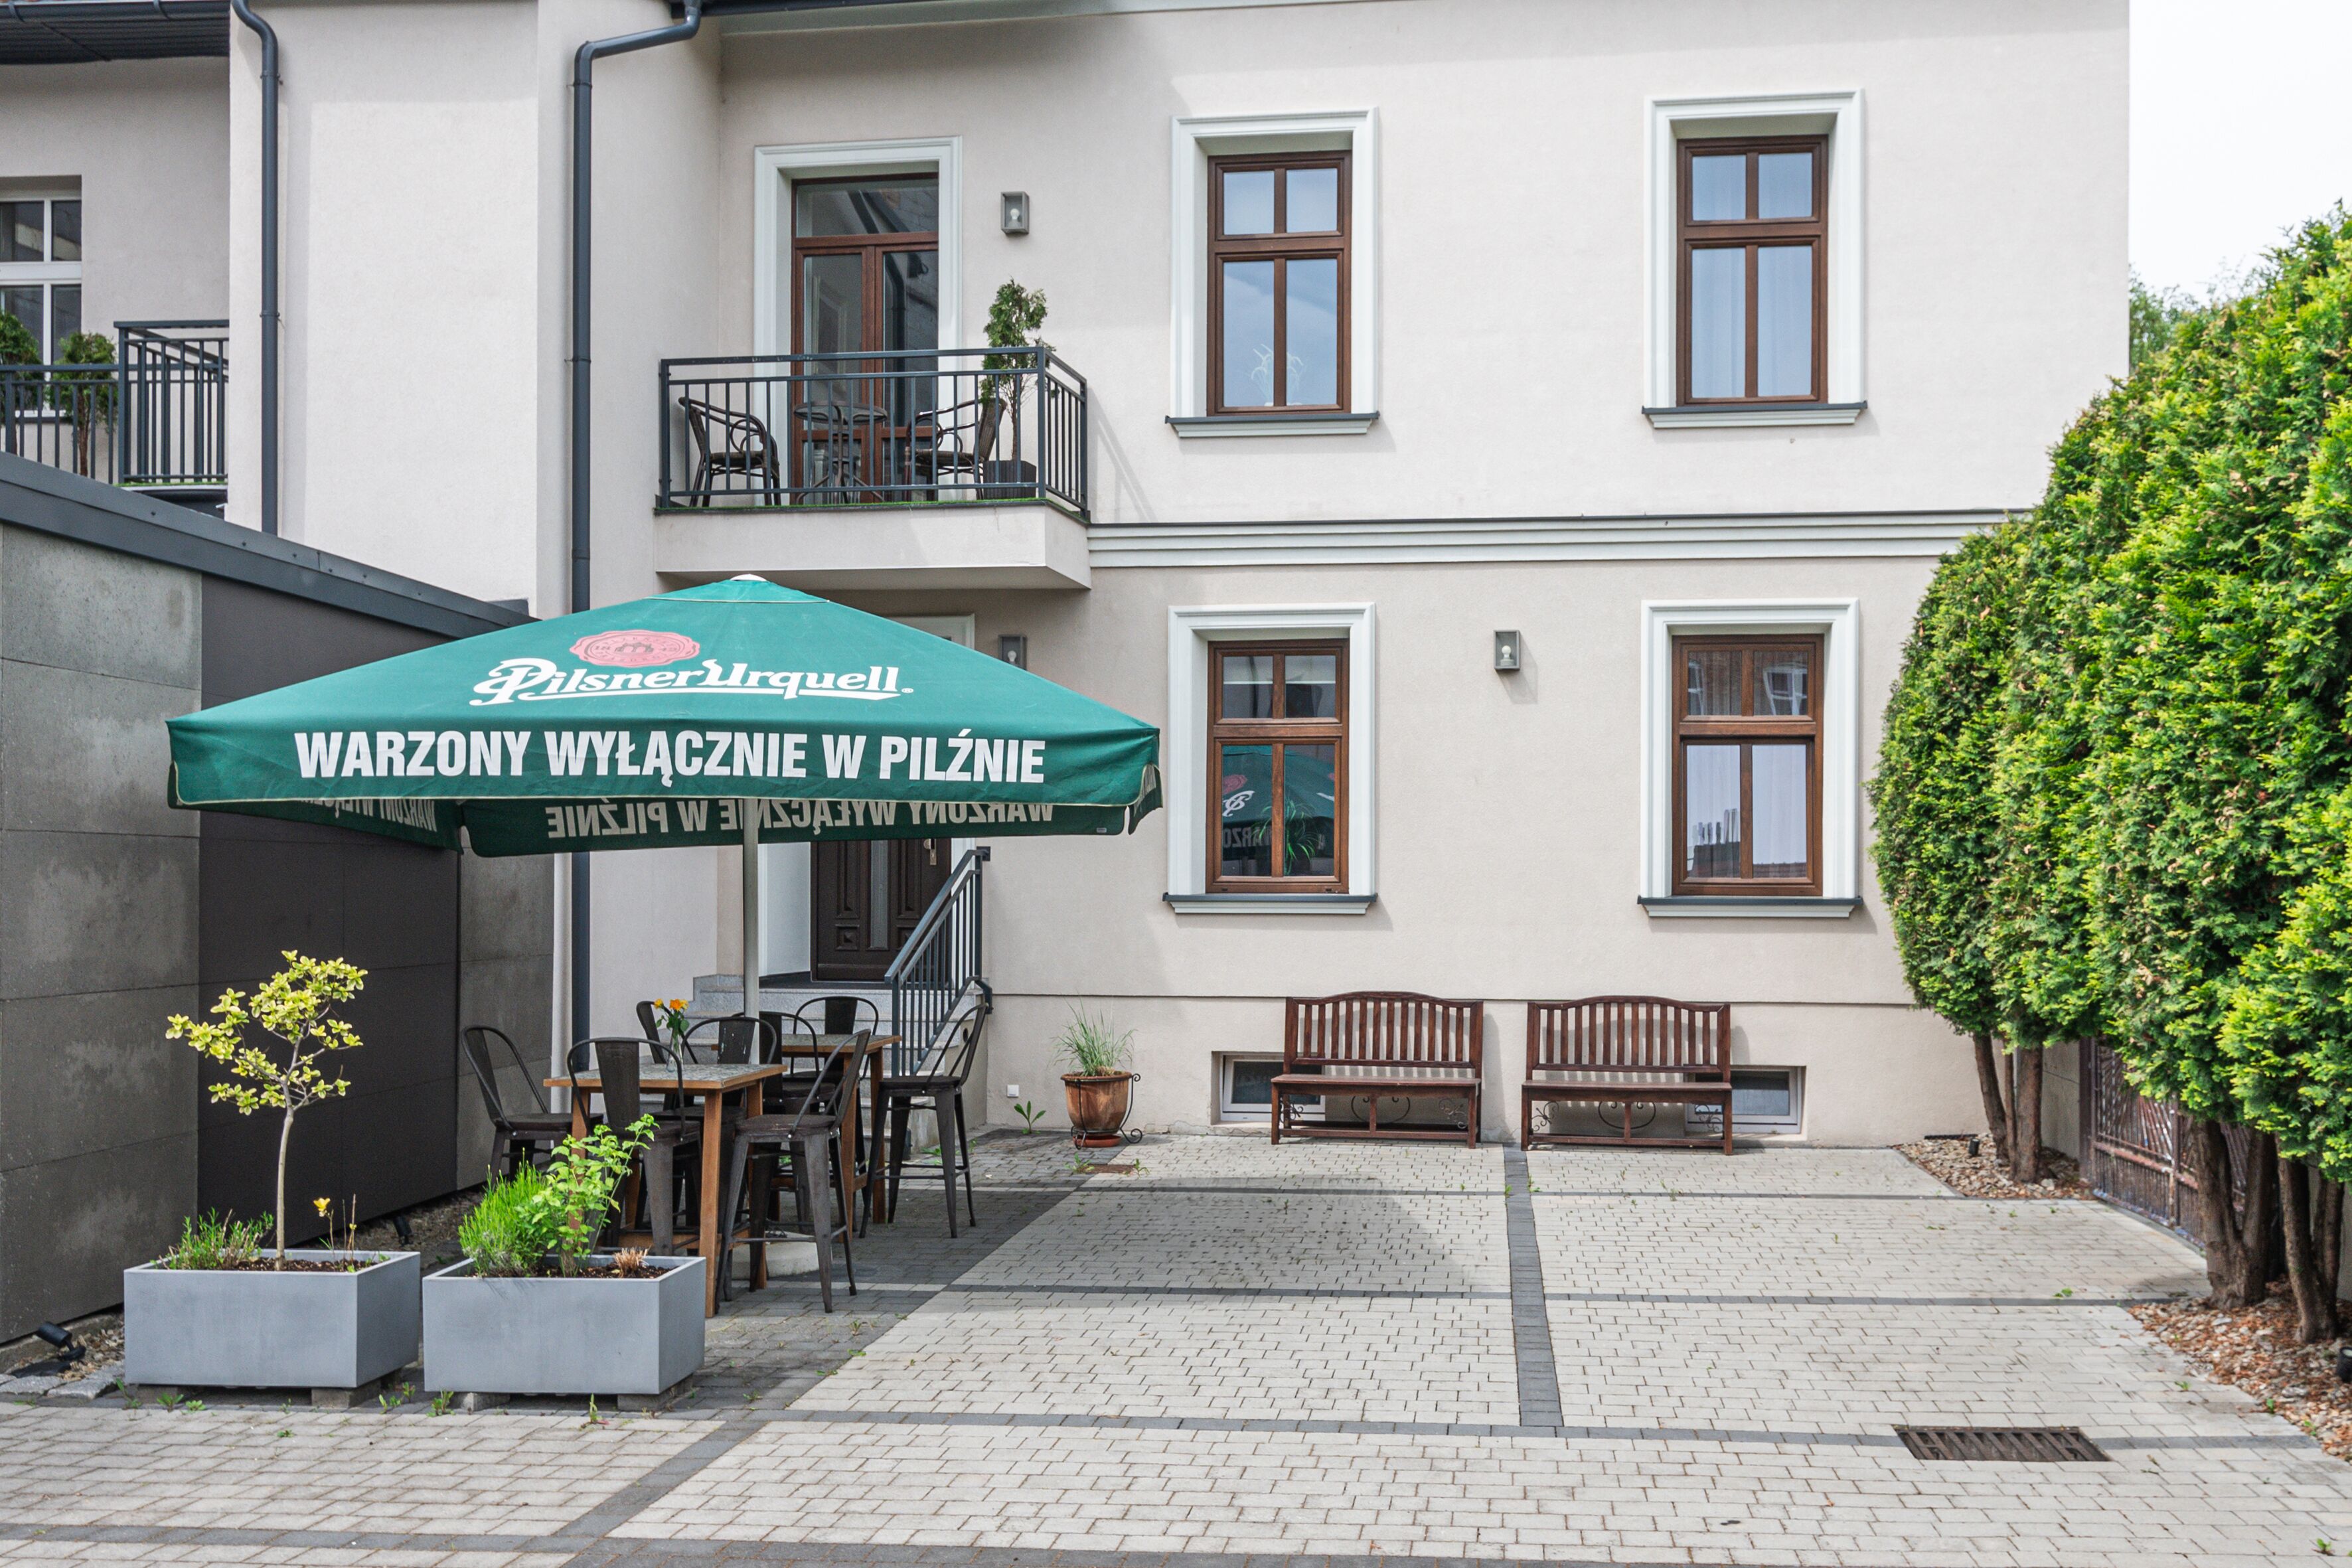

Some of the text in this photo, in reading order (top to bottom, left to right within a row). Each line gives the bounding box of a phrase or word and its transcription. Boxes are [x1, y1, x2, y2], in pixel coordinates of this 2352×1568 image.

[469, 657, 900, 706] Pilsner Urquell
[293, 728, 1046, 787] WARZONY WYŁĄCZNIE W PILŹNIE
